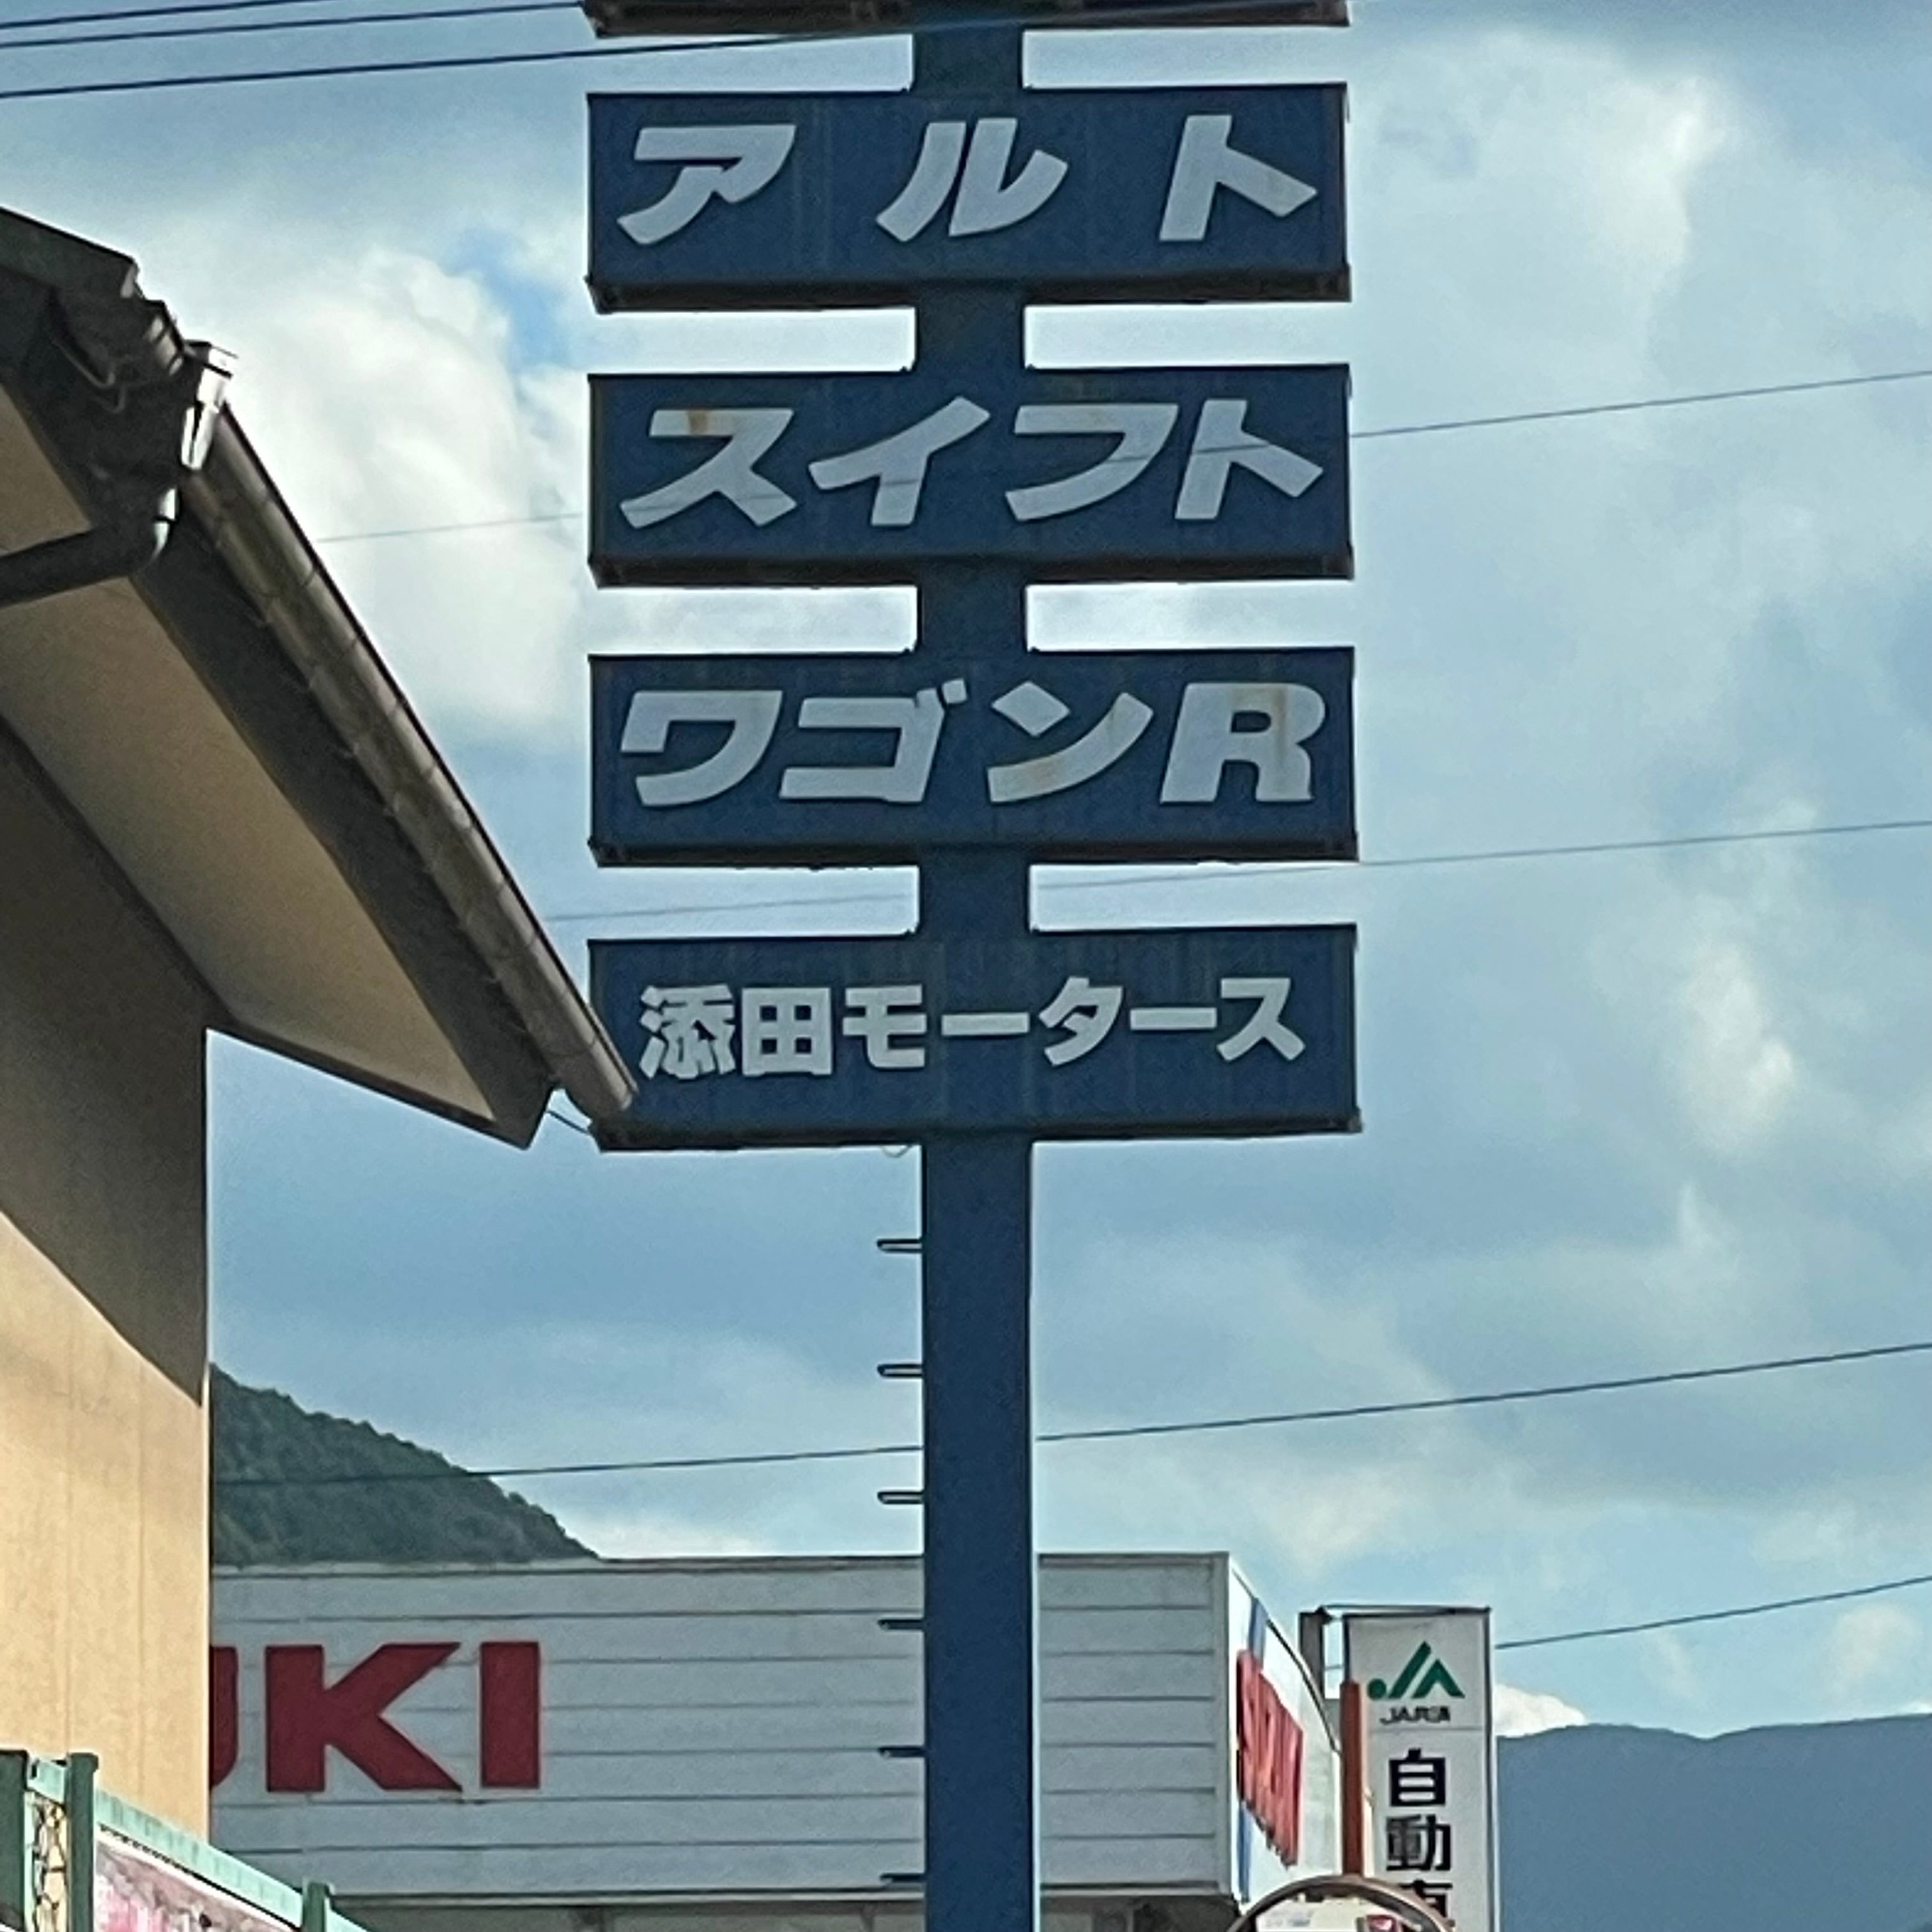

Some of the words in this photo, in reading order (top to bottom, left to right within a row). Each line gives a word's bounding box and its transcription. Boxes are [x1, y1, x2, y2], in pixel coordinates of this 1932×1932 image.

[617, 114, 1318, 245] アルト
[620, 396, 1323, 528] スイフト
[620, 678, 1326, 806] ワゴンR
[639, 976, 1305, 1079] 添田モータース
